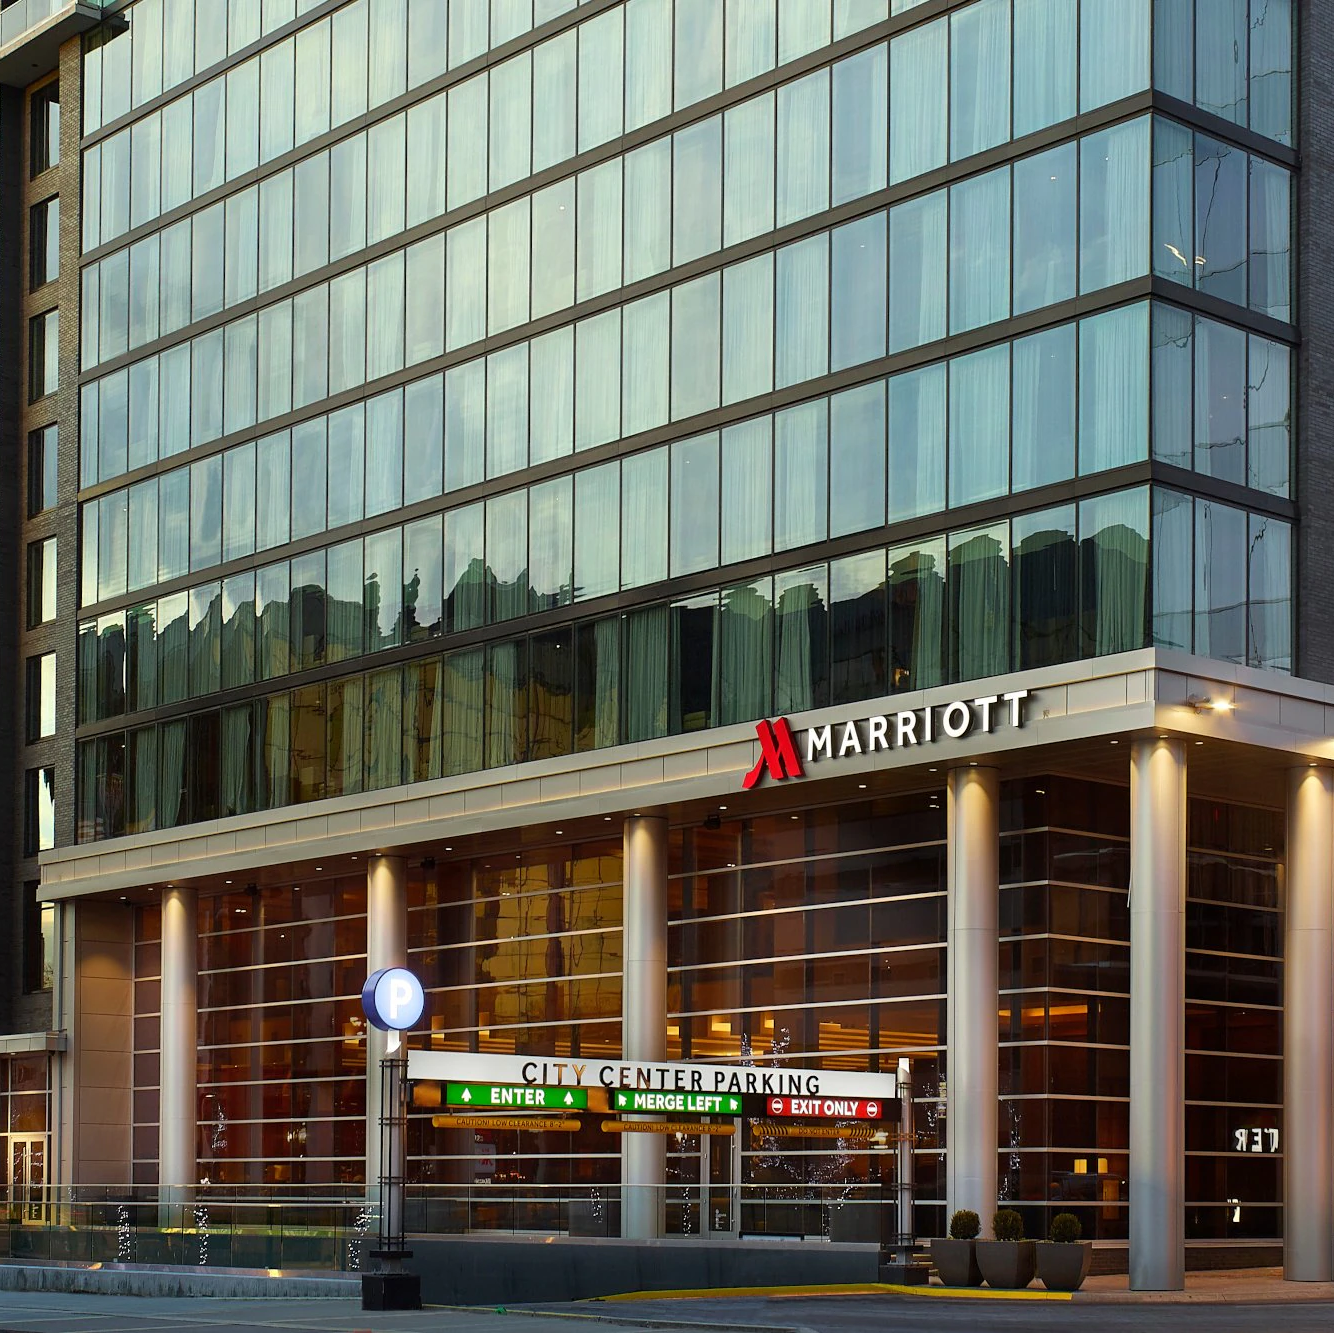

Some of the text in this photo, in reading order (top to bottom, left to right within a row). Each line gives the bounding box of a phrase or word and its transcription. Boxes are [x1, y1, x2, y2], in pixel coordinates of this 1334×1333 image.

[807, 690, 1028, 762] MARRIOTT
[390, 978, 412, 1020] P
[521, 1062, 820, 1097] CITY CENTER PARKING
[490, 1087, 545, 1105] ENTER
[634, 1093, 722, 1112] MERGE LEFT
[790, 1098, 859, 1117] EXIT ONLY
[456, 1117, 490, 1126] CAUTION!
[491, 1118, 507, 1127] LOW
[508, 1119, 547, 1128] CLEARANCE
